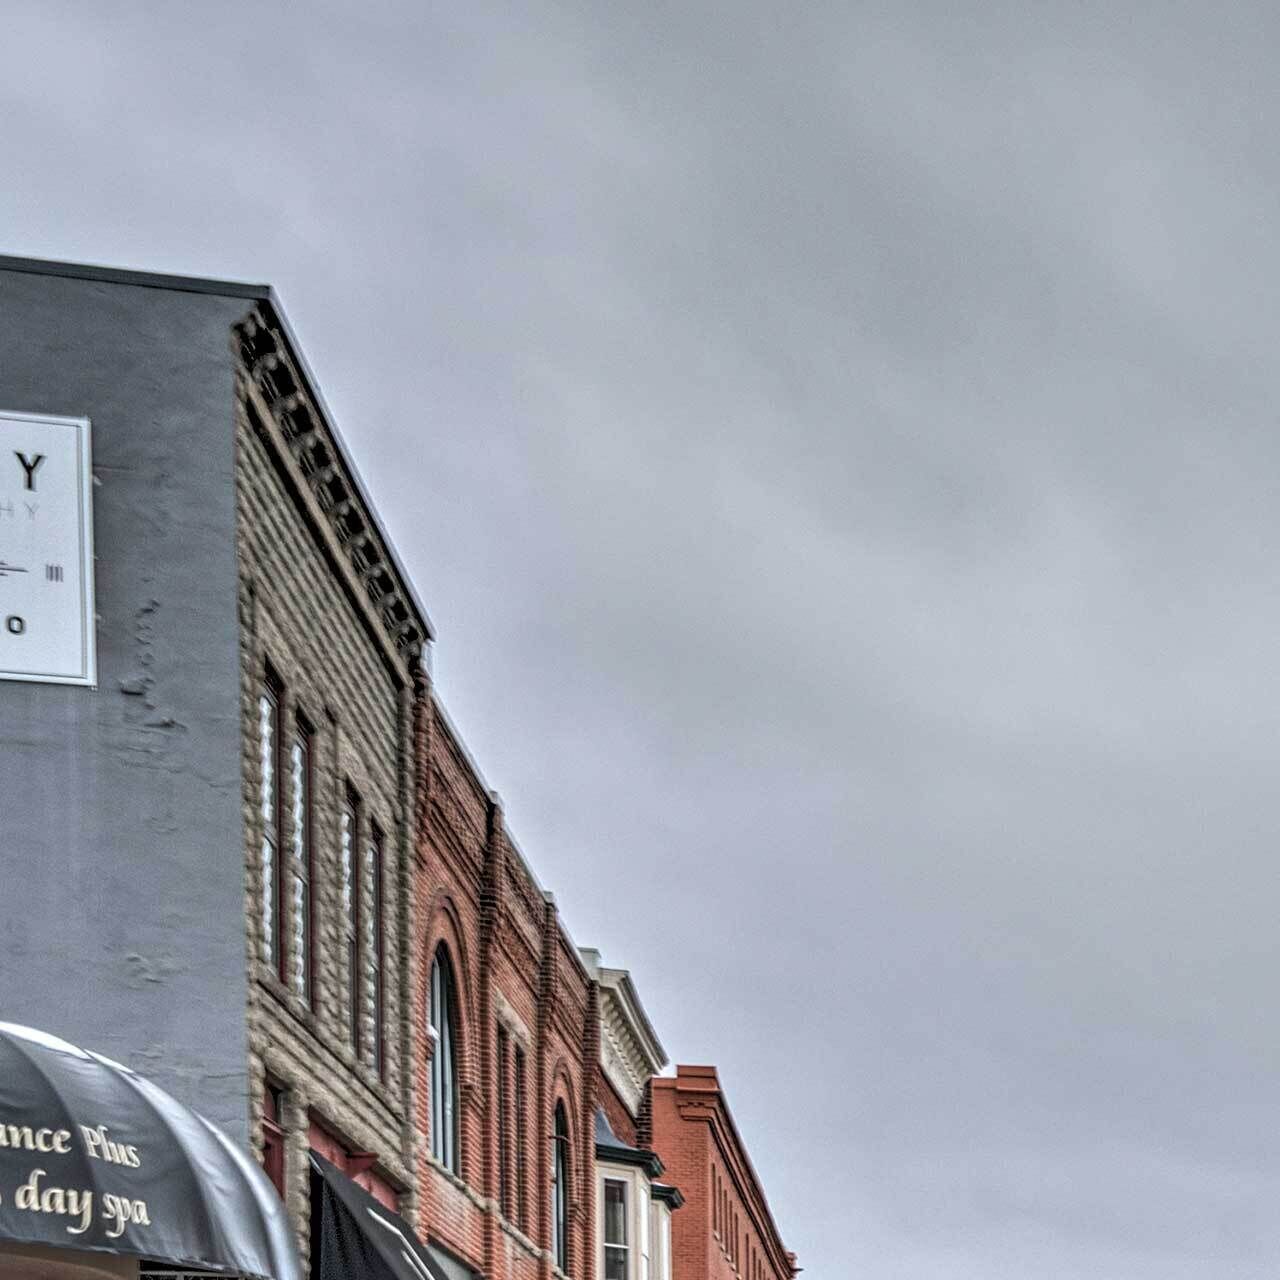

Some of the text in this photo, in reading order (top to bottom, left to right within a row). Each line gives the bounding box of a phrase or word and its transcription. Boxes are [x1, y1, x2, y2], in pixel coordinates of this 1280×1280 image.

[79, 1124, 141, 1168] Plus
[15, 1169, 150, 1238] day spa
